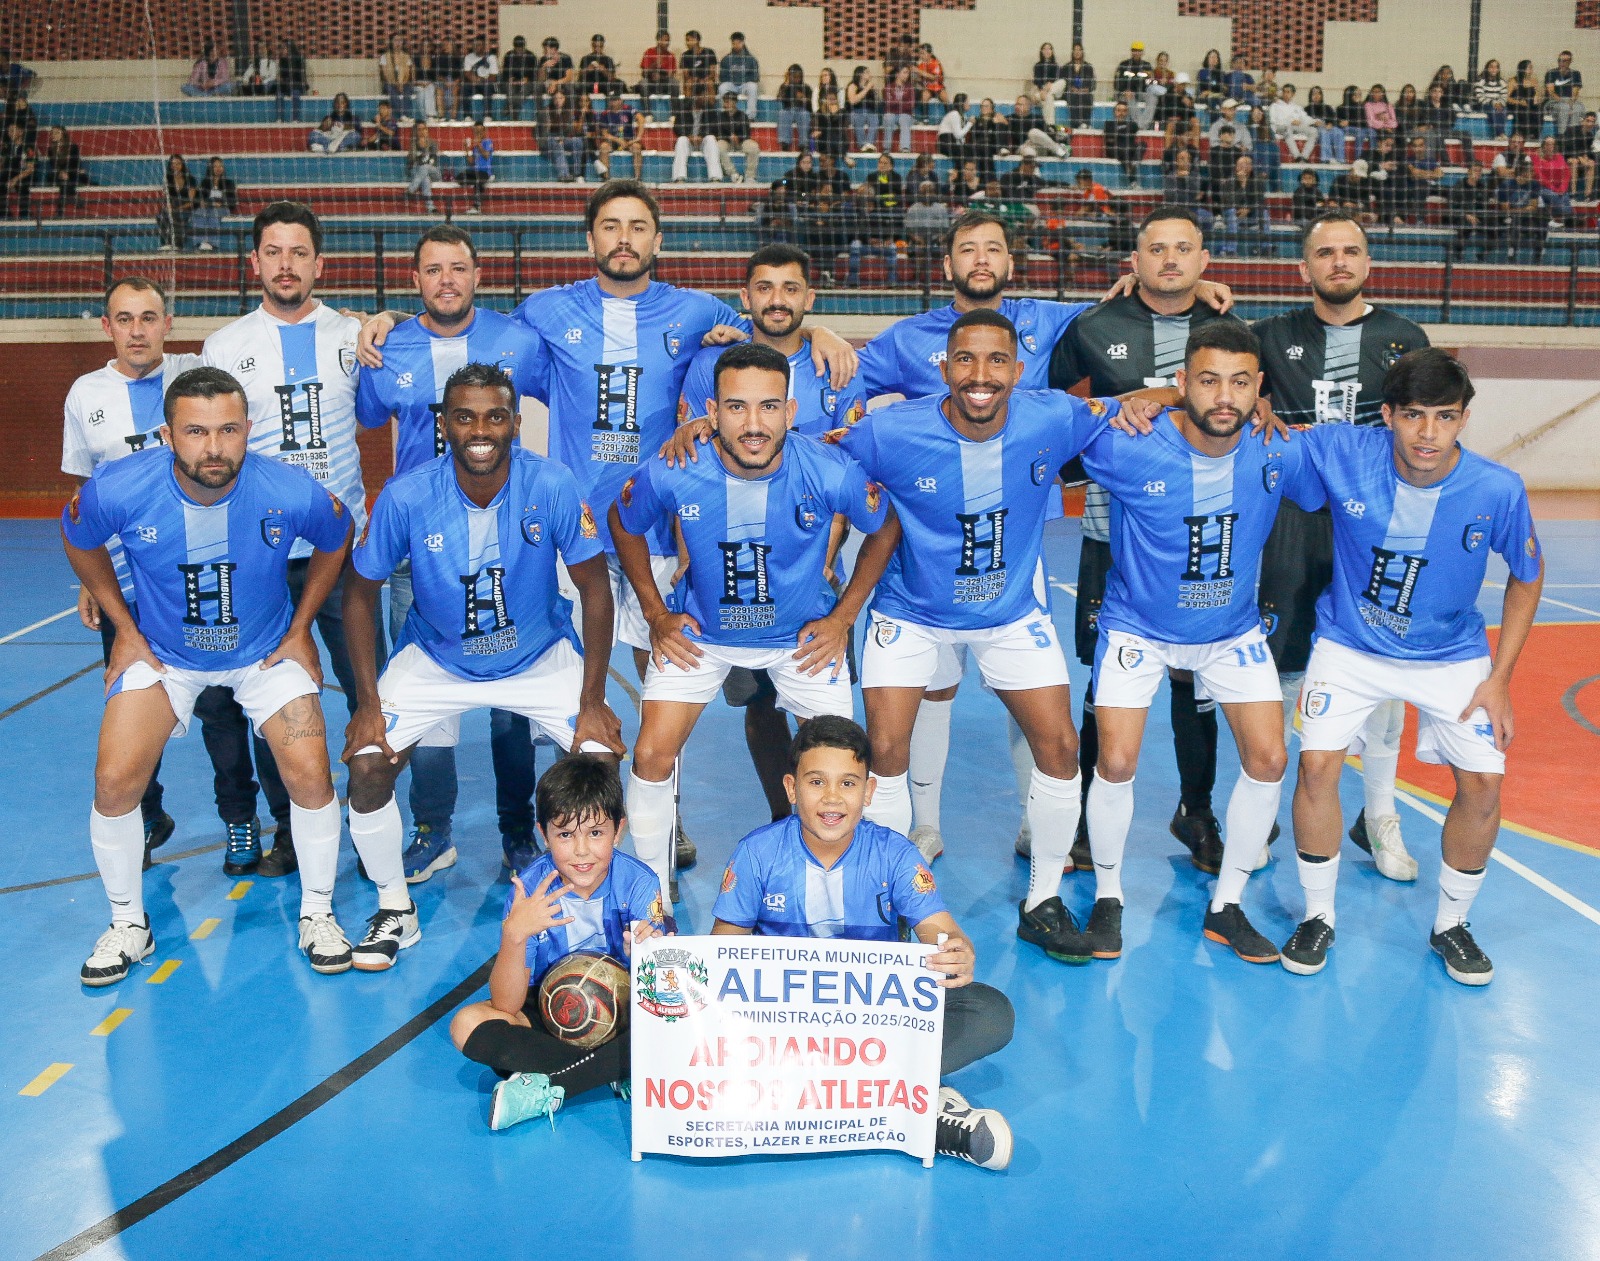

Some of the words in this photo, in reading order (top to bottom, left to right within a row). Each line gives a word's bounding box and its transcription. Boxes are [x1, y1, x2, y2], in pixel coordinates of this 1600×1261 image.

[625, 368, 638, 430] HAMBURGÃO
[1345, 385, 1355, 422] HAMBU
[308, 384, 323, 447] HAMBURGÃO
[601, 433, 640, 444] 3291-9365
[601, 443, 639, 453] 3291-7286
[290, 451, 328, 462] 3291-9365
[603, 453, 638, 463] 9129-0141
[678, 503, 700, 517] LR
[992, 512, 1003, 569] HAMBURGÃO
[1219, 516, 1232, 577] HAMBURGÃO
[756, 546, 768, 602] HAMBURGÃO
[966, 570, 1006, 586] 3291-9365
[1190, 580, 1233, 591] 3291-9365
[1396, 558, 1420, 614] HAMBURGÃO
[219, 564, 232, 624] HAMBURGÃO
[493, 569, 507, 627] HAMBURGÃO
[1189, 589, 1232, 600] 3291-7286
[730, 605, 775, 614] 3291-9365
[1192, 598, 1230, 608] 9129-0141
[731, 613, 775, 622] 3291-7286
[735, 620, 774, 629] 9129-0141
[194, 625, 239, 636] 3291-9365
[195, 633, 238, 643] 3291-7286
[1027, 622, 1051, 649] 5
[199, 641, 238, 651] 9129-0141
[1233, 640, 1268, 667] 10
[763, 892, 786, 907] LR
[717, 947, 821, 962] PREFEITURA
[825, 951, 914, 967] MUNICIPAL
[717, 968, 939, 1012] ALFENAS
[729, 1009, 857, 1028] DMINISTRAÇÃO
[862, 1012, 936, 1033] 2025/2028
[797, 1079, 930, 1115] ATLETAS
[686, 1120, 780, 1132] SECRETARIA
[784, 1119, 865, 1131] MUNICIPAL
[869, 1116, 888, 1127] DE
[668, 1135, 748, 1149] ESPORTES,
[753, 1135, 800, 1147] LAZER
[805, 1135, 814, 1145] E
[818, 1129, 906, 1145] RECREAÇÃO
